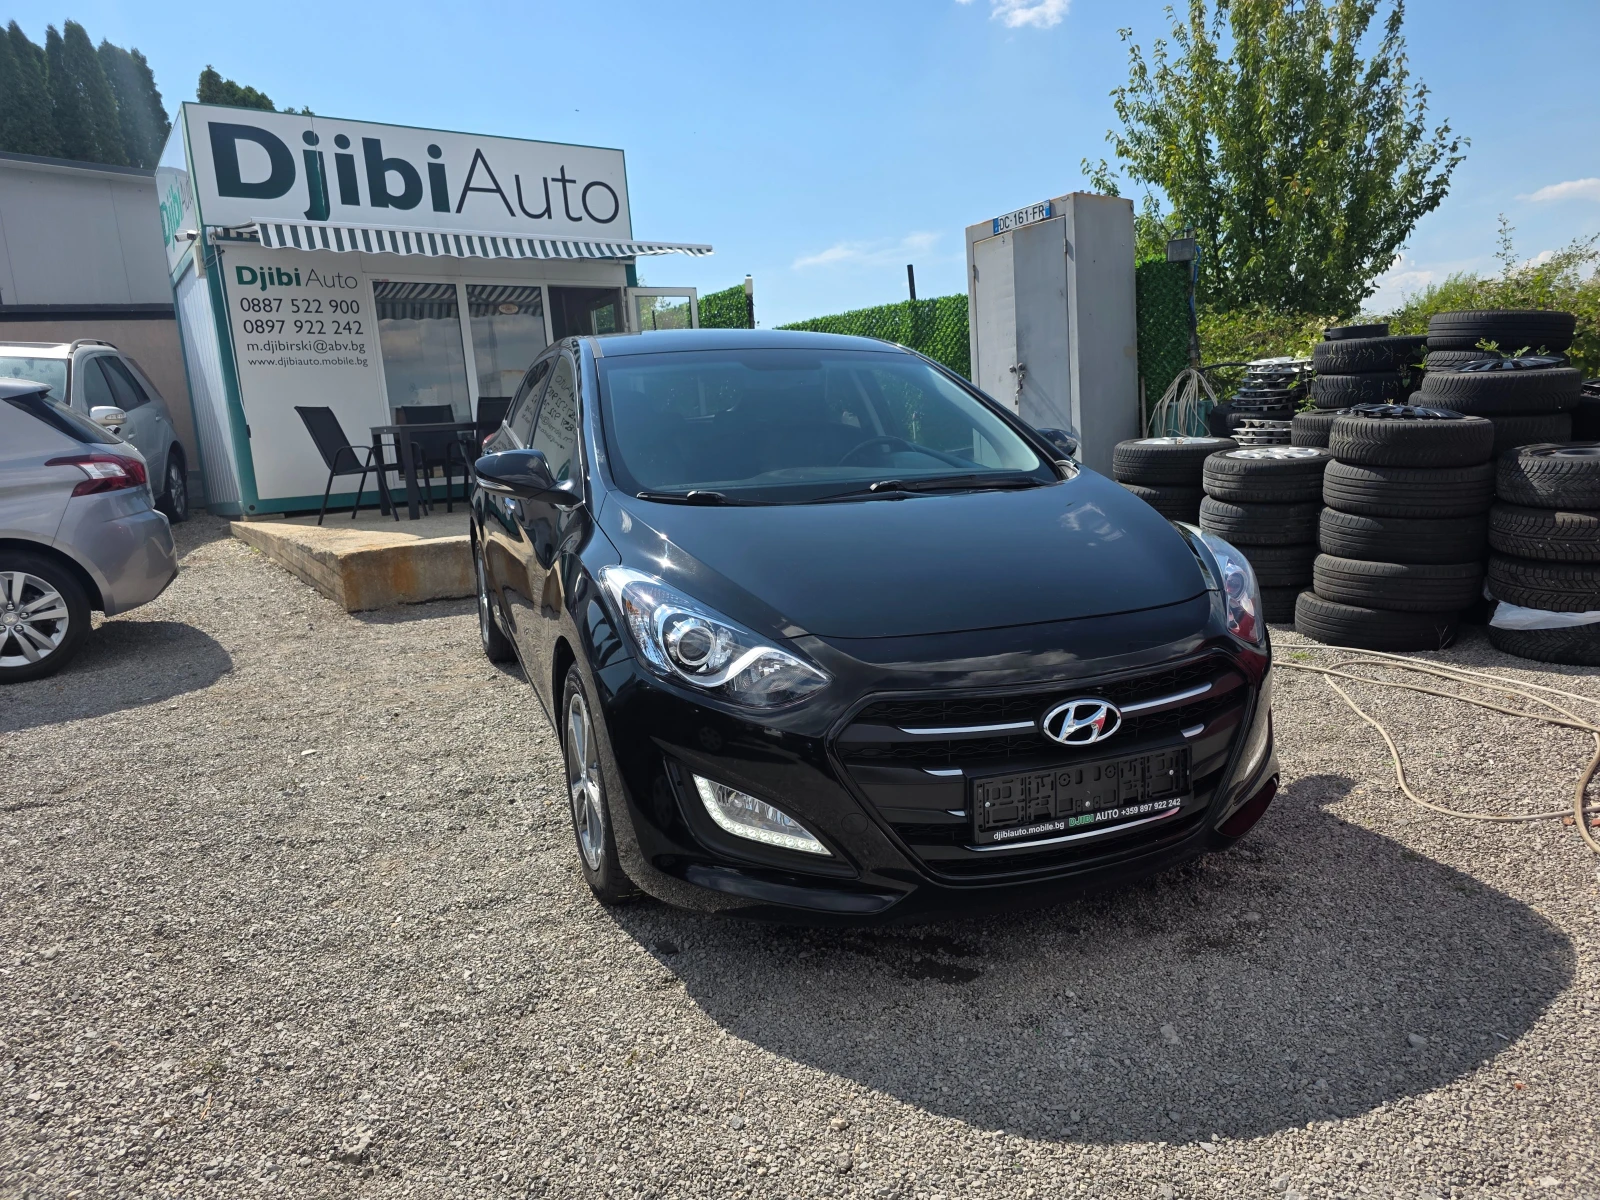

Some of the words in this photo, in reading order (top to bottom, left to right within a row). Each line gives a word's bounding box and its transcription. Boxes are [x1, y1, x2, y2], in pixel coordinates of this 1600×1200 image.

[1000, 205, 1045, 231] DC-161-FR
[236, 266, 301, 291] Djibi
[306, 268, 358, 289] Auto
[240, 298, 282, 312] 0887
[291, 299, 324, 313] 522
[328, 300, 360, 314] 900
[243, 320, 285, 334] 0897
[294, 320, 326, 334] 922
[332, 320, 363, 334] 242
[247, 340, 366, 354] m.djibirski@abv.bg
[248, 357, 368, 368] www.djibiauto.mobile.bg
[993, 821, 1065, 841] djibiauto.mobile.bg
[1068, 813, 1095, 827] DJIBI
[1095, 808, 1119, 822] AUTO
[1120, 807, 1139, 816] +359
[1139, 803, 1153, 813] 897
[1153, 801, 1167, 810] 922
[1168, 798, 1181, 808] 242
